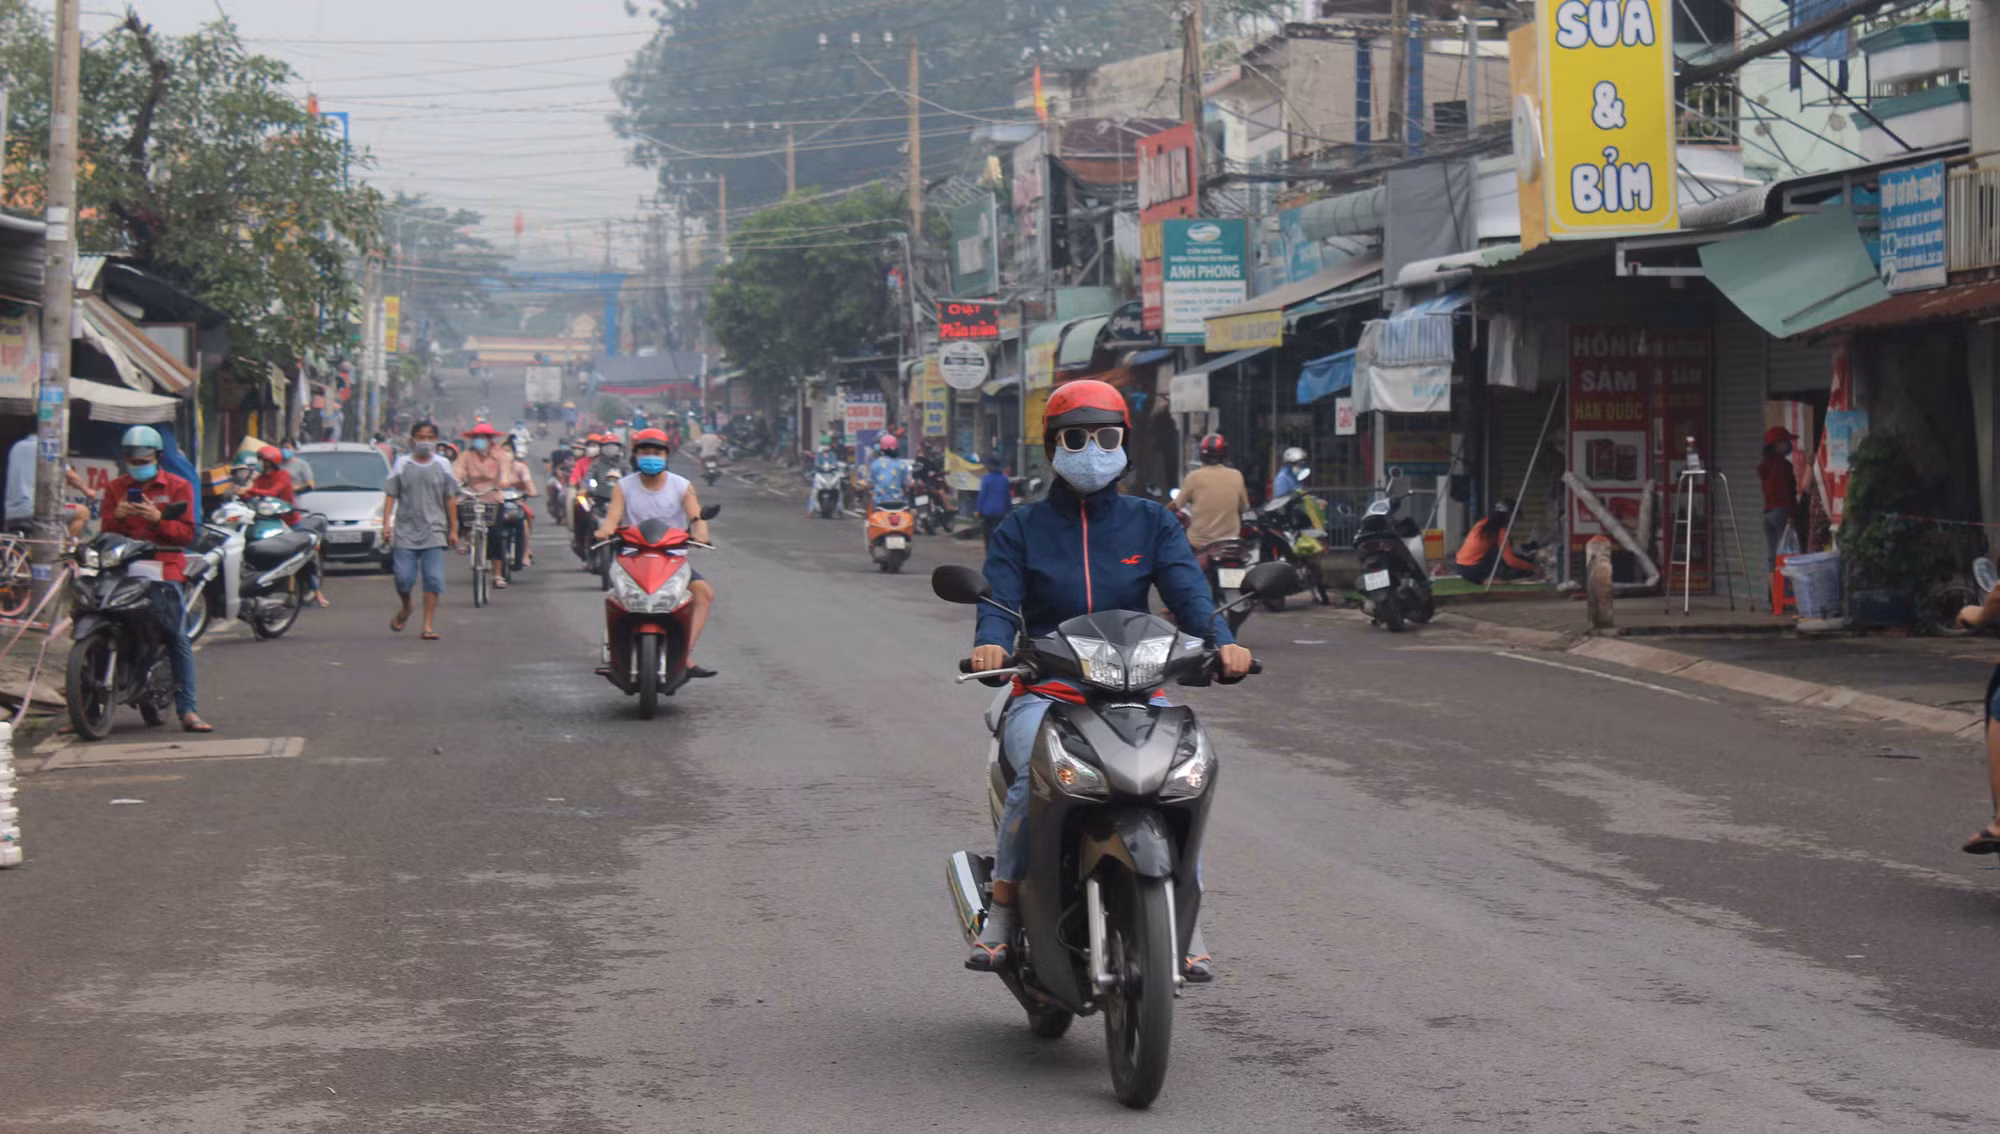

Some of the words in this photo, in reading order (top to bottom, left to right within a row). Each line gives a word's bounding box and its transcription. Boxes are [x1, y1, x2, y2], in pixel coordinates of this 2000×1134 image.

[1592, 80, 1626, 130] &
[1571, 146, 1653, 213] BỈM
[1170, 265, 1196, 279] ANH
[1198, 264, 1241, 279] PHONG
